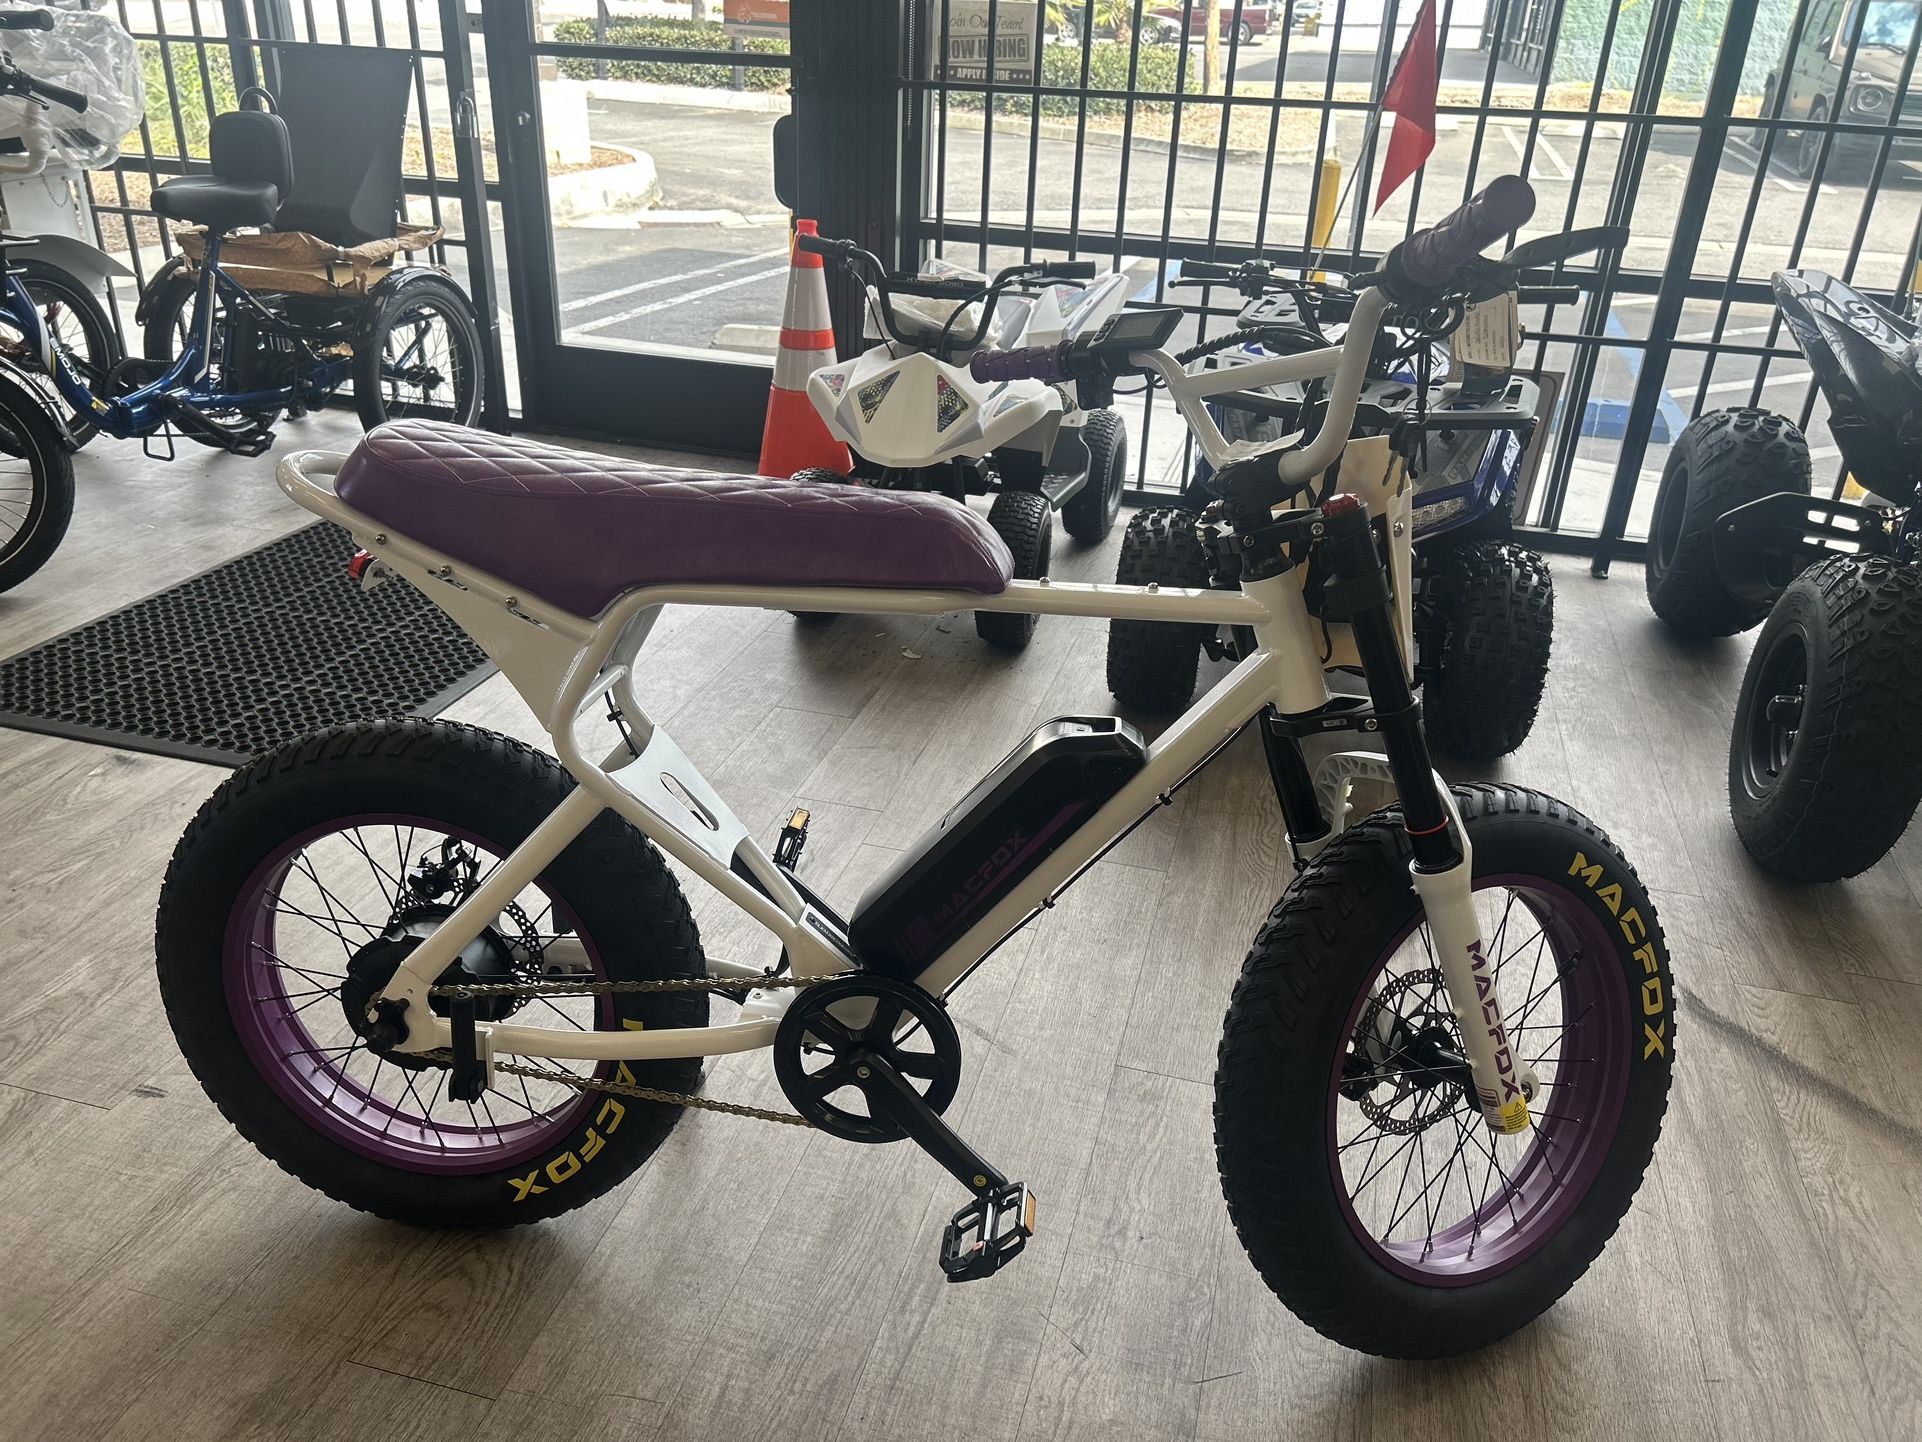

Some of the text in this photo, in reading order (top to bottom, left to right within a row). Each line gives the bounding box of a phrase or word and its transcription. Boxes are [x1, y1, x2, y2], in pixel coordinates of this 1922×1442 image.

[947, 12, 1025, 30] oin Ou Team!
[948, 38, 1026, 59] OW HRING
[956, 68, 1010, 81] APPLY IIDE
[49, 337, 82, 386] EMOJO
[934, 828, 1030, 925] MACFOX
[1567, 851, 1665, 1061] MACFOX
[1466, 938, 1521, 1103] MACFOX
